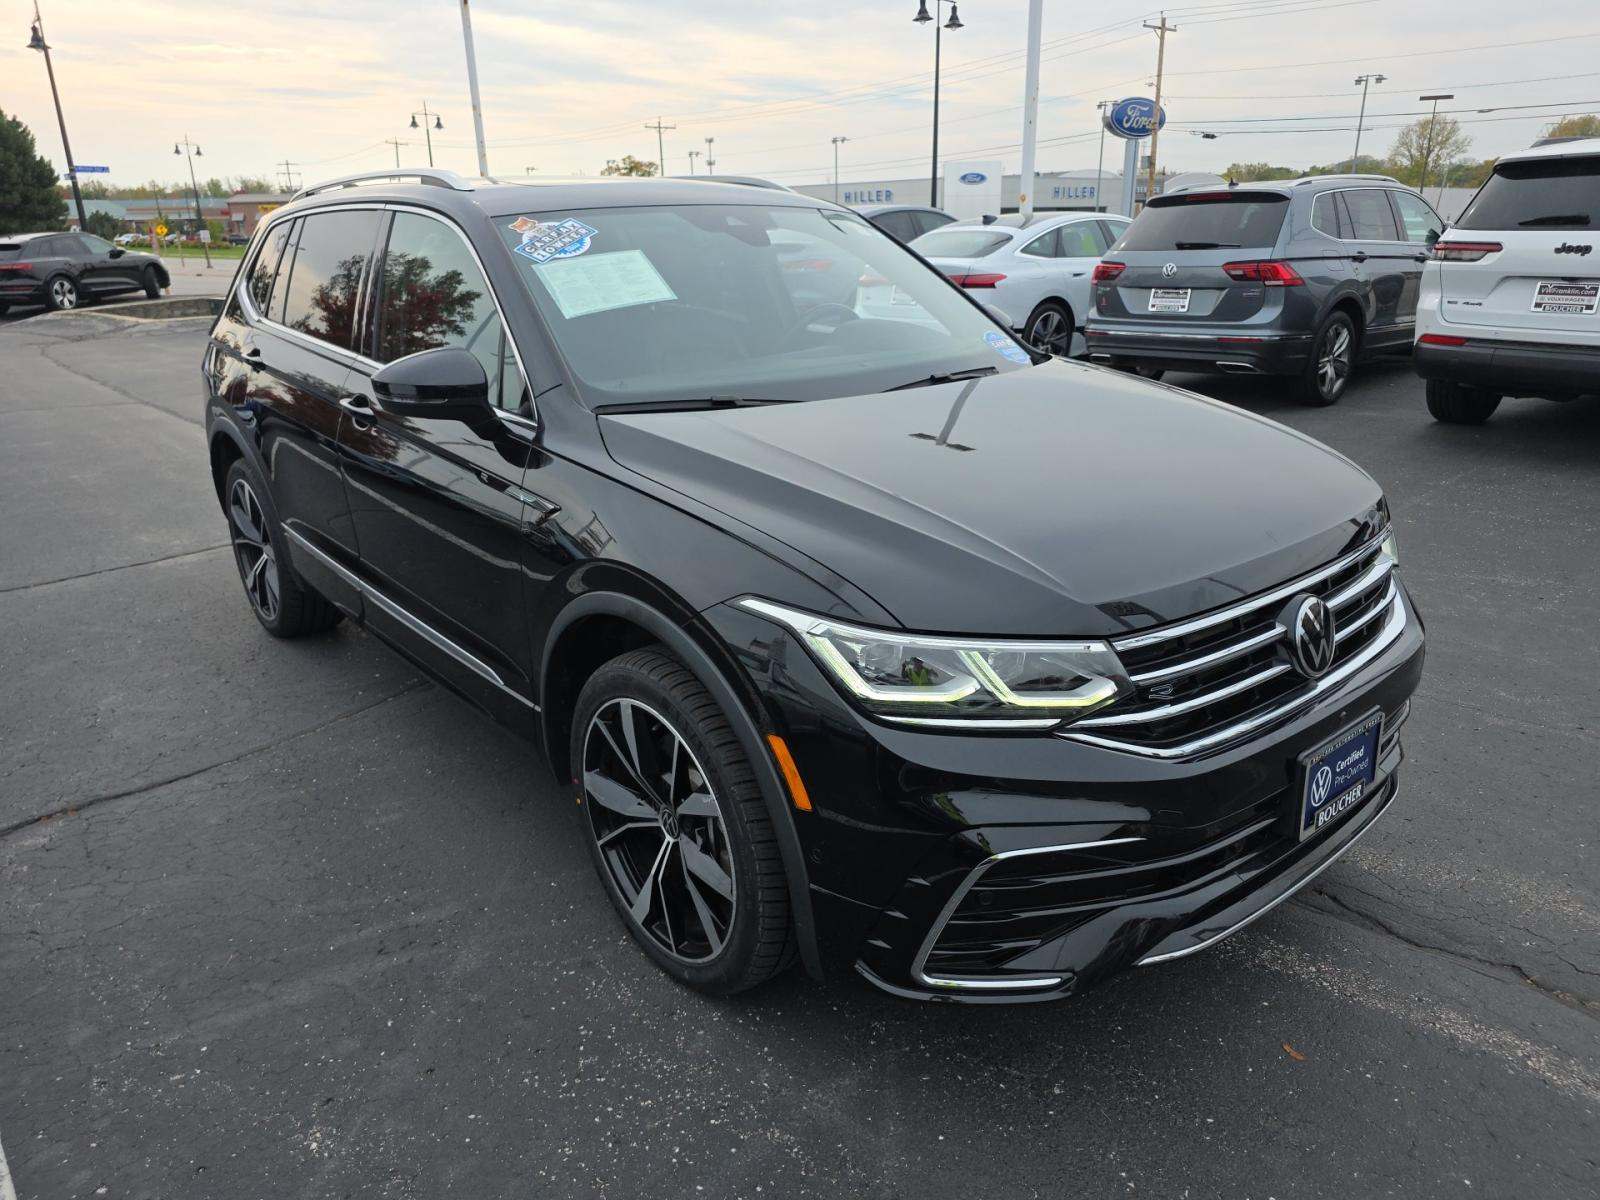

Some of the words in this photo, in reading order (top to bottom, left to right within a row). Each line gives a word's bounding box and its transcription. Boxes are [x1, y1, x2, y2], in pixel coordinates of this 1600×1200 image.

[844, 189, 893, 202] HILLER
[1054, 186, 1096, 199] HILLER
[525, 223, 578, 253] CARFAX
[1554, 242, 1593, 256] Jeep
[1541, 287, 1596, 296] VWFranklin.com
[1544, 304, 1582, 312] BOUCHER
[1335, 745, 1365, 772] Certified
[1334, 758, 1369, 788] Pre-Owned
[1318, 785, 1362, 826] BOUCHER
